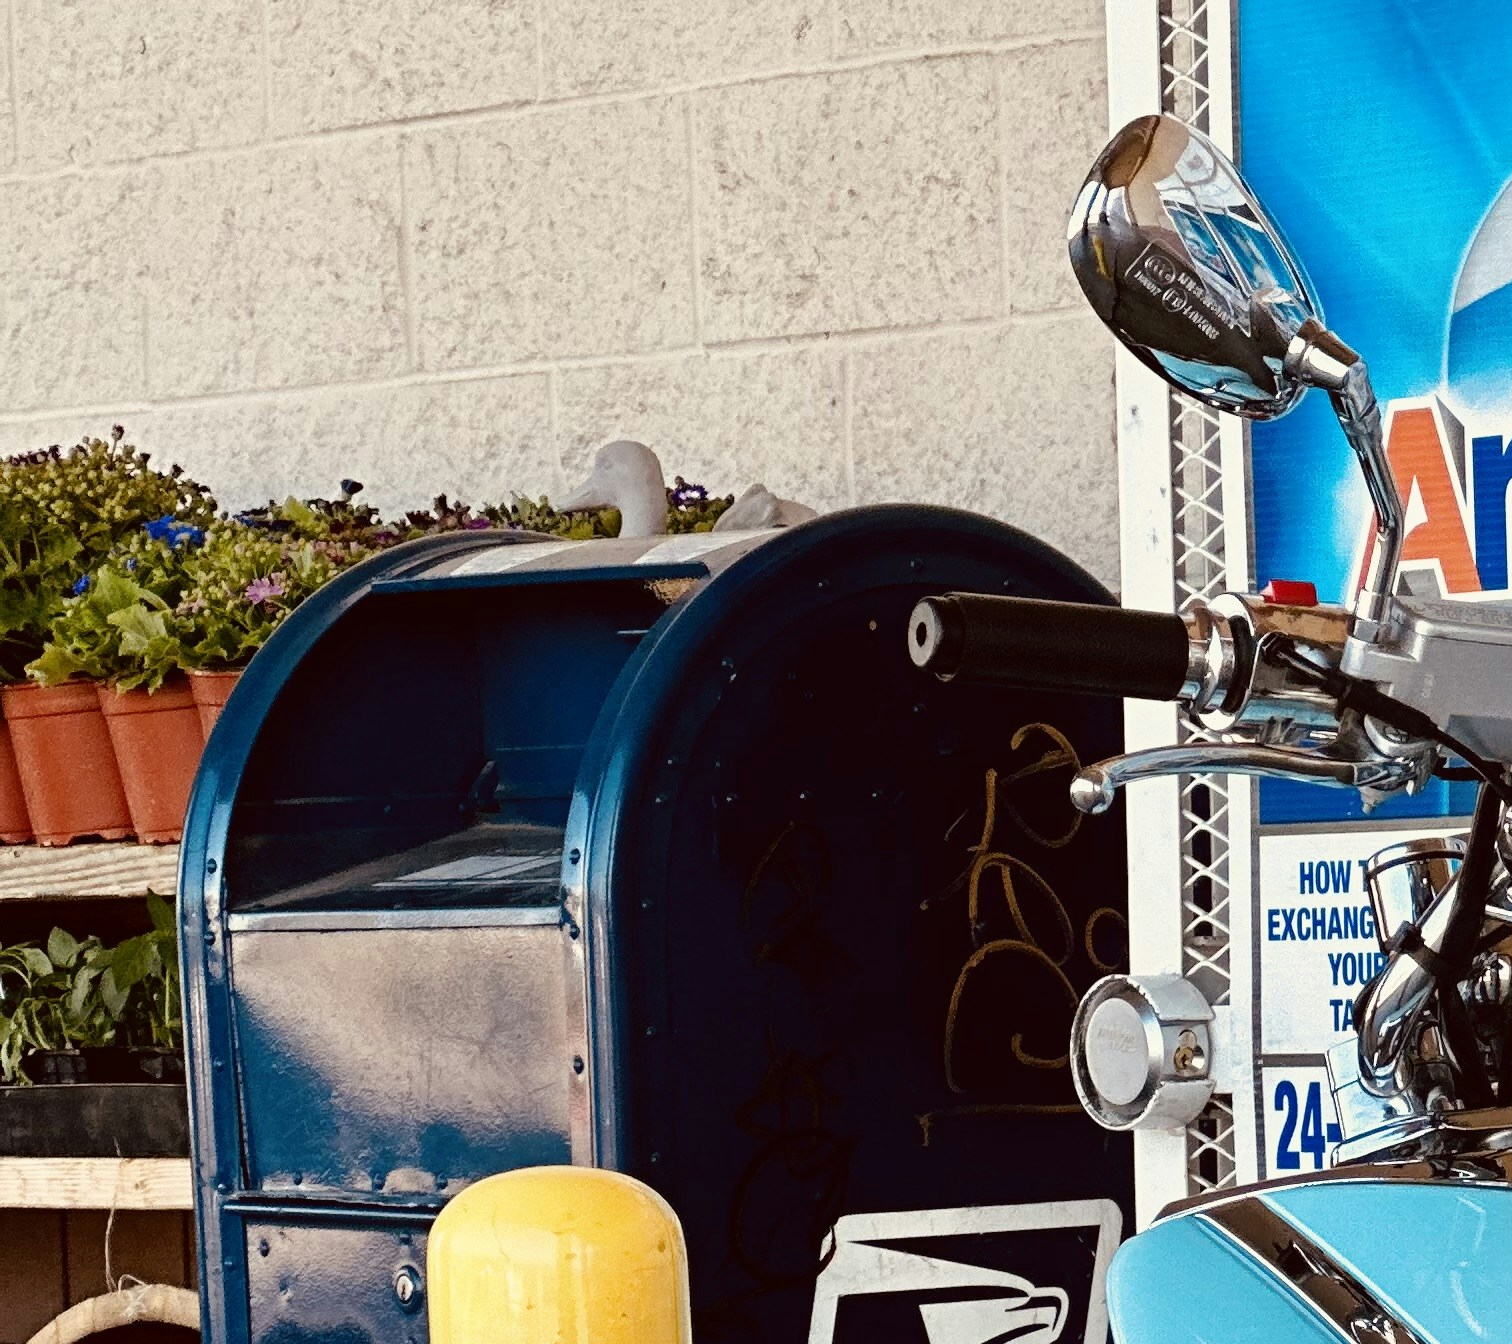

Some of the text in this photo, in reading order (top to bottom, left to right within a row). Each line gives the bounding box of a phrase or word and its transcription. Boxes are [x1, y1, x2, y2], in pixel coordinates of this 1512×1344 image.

[1299, 859, 1369, 895] HOW T
[1267, 906, 1374, 942] EXCHANG
[1329, 999, 1355, 1032] TA
[1275, 1081, 1342, 1170] 24-
